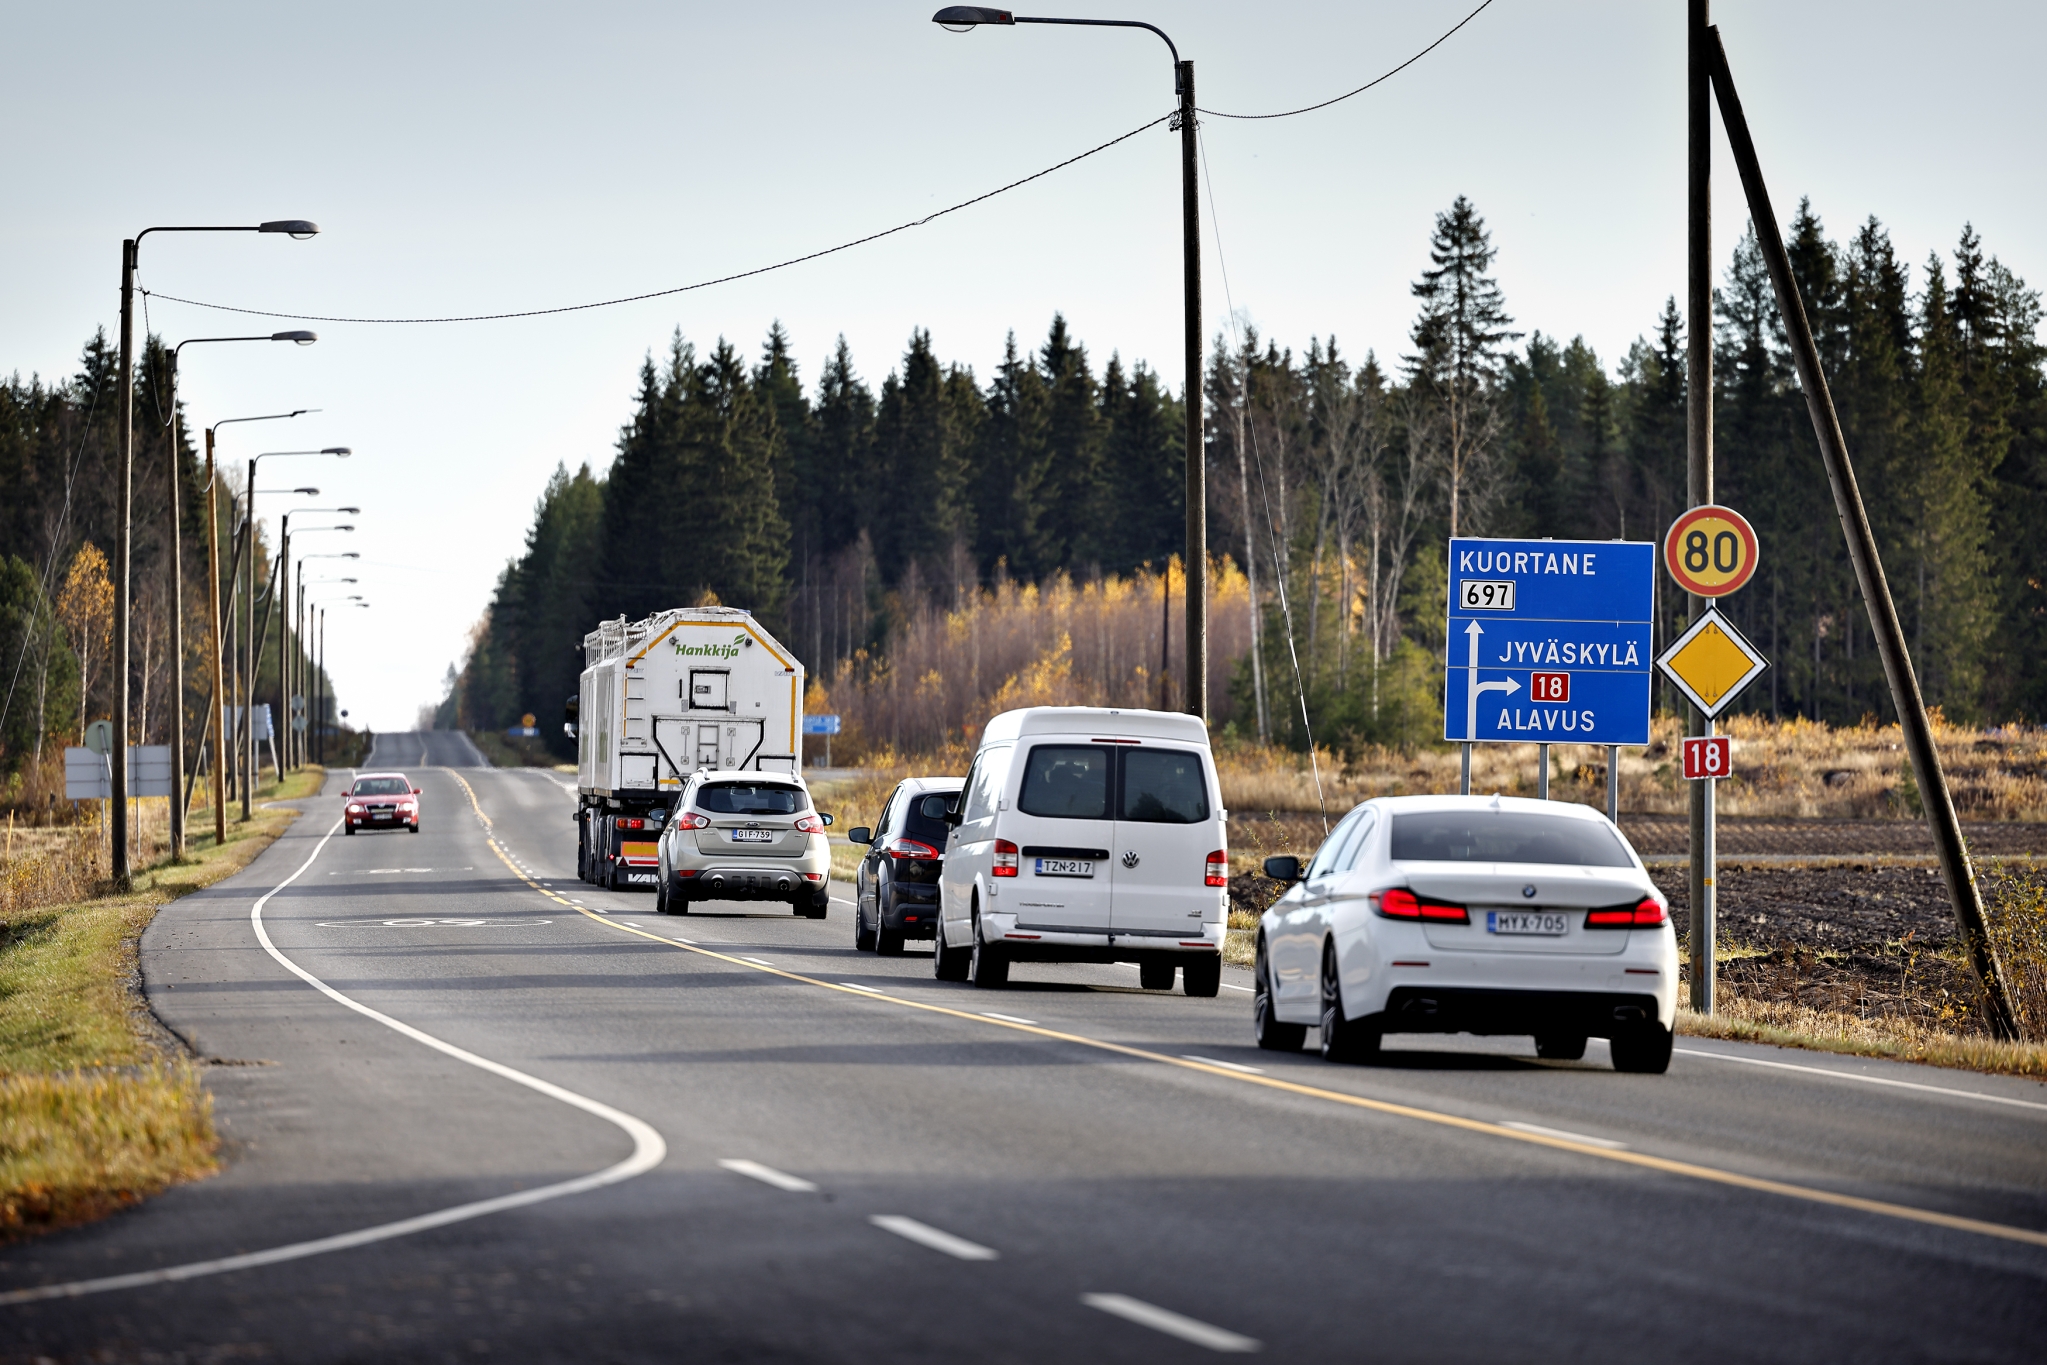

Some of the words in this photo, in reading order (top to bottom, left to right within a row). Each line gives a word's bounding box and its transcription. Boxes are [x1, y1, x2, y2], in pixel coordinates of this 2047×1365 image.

[1685, 530, 1738, 573] 80
[1459, 551, 1596, 575] KUORTANE
[1467, 584, 1508, 606] 697
[675, 644, 739, 660] Hankkija
[1499, 639, 1639, 665] JYVÄSKYLÄ
[1538, 677, 1563, 698] 18
[1497, 709, 1595, 731] ALAVUS
[1691, 743, 1721, 773] 18
[738, 830, 770, 838] GIF-739
[1045, 860, 1091, 873] TZN-217
[1499, 914, 1565, 930] MYX-705
